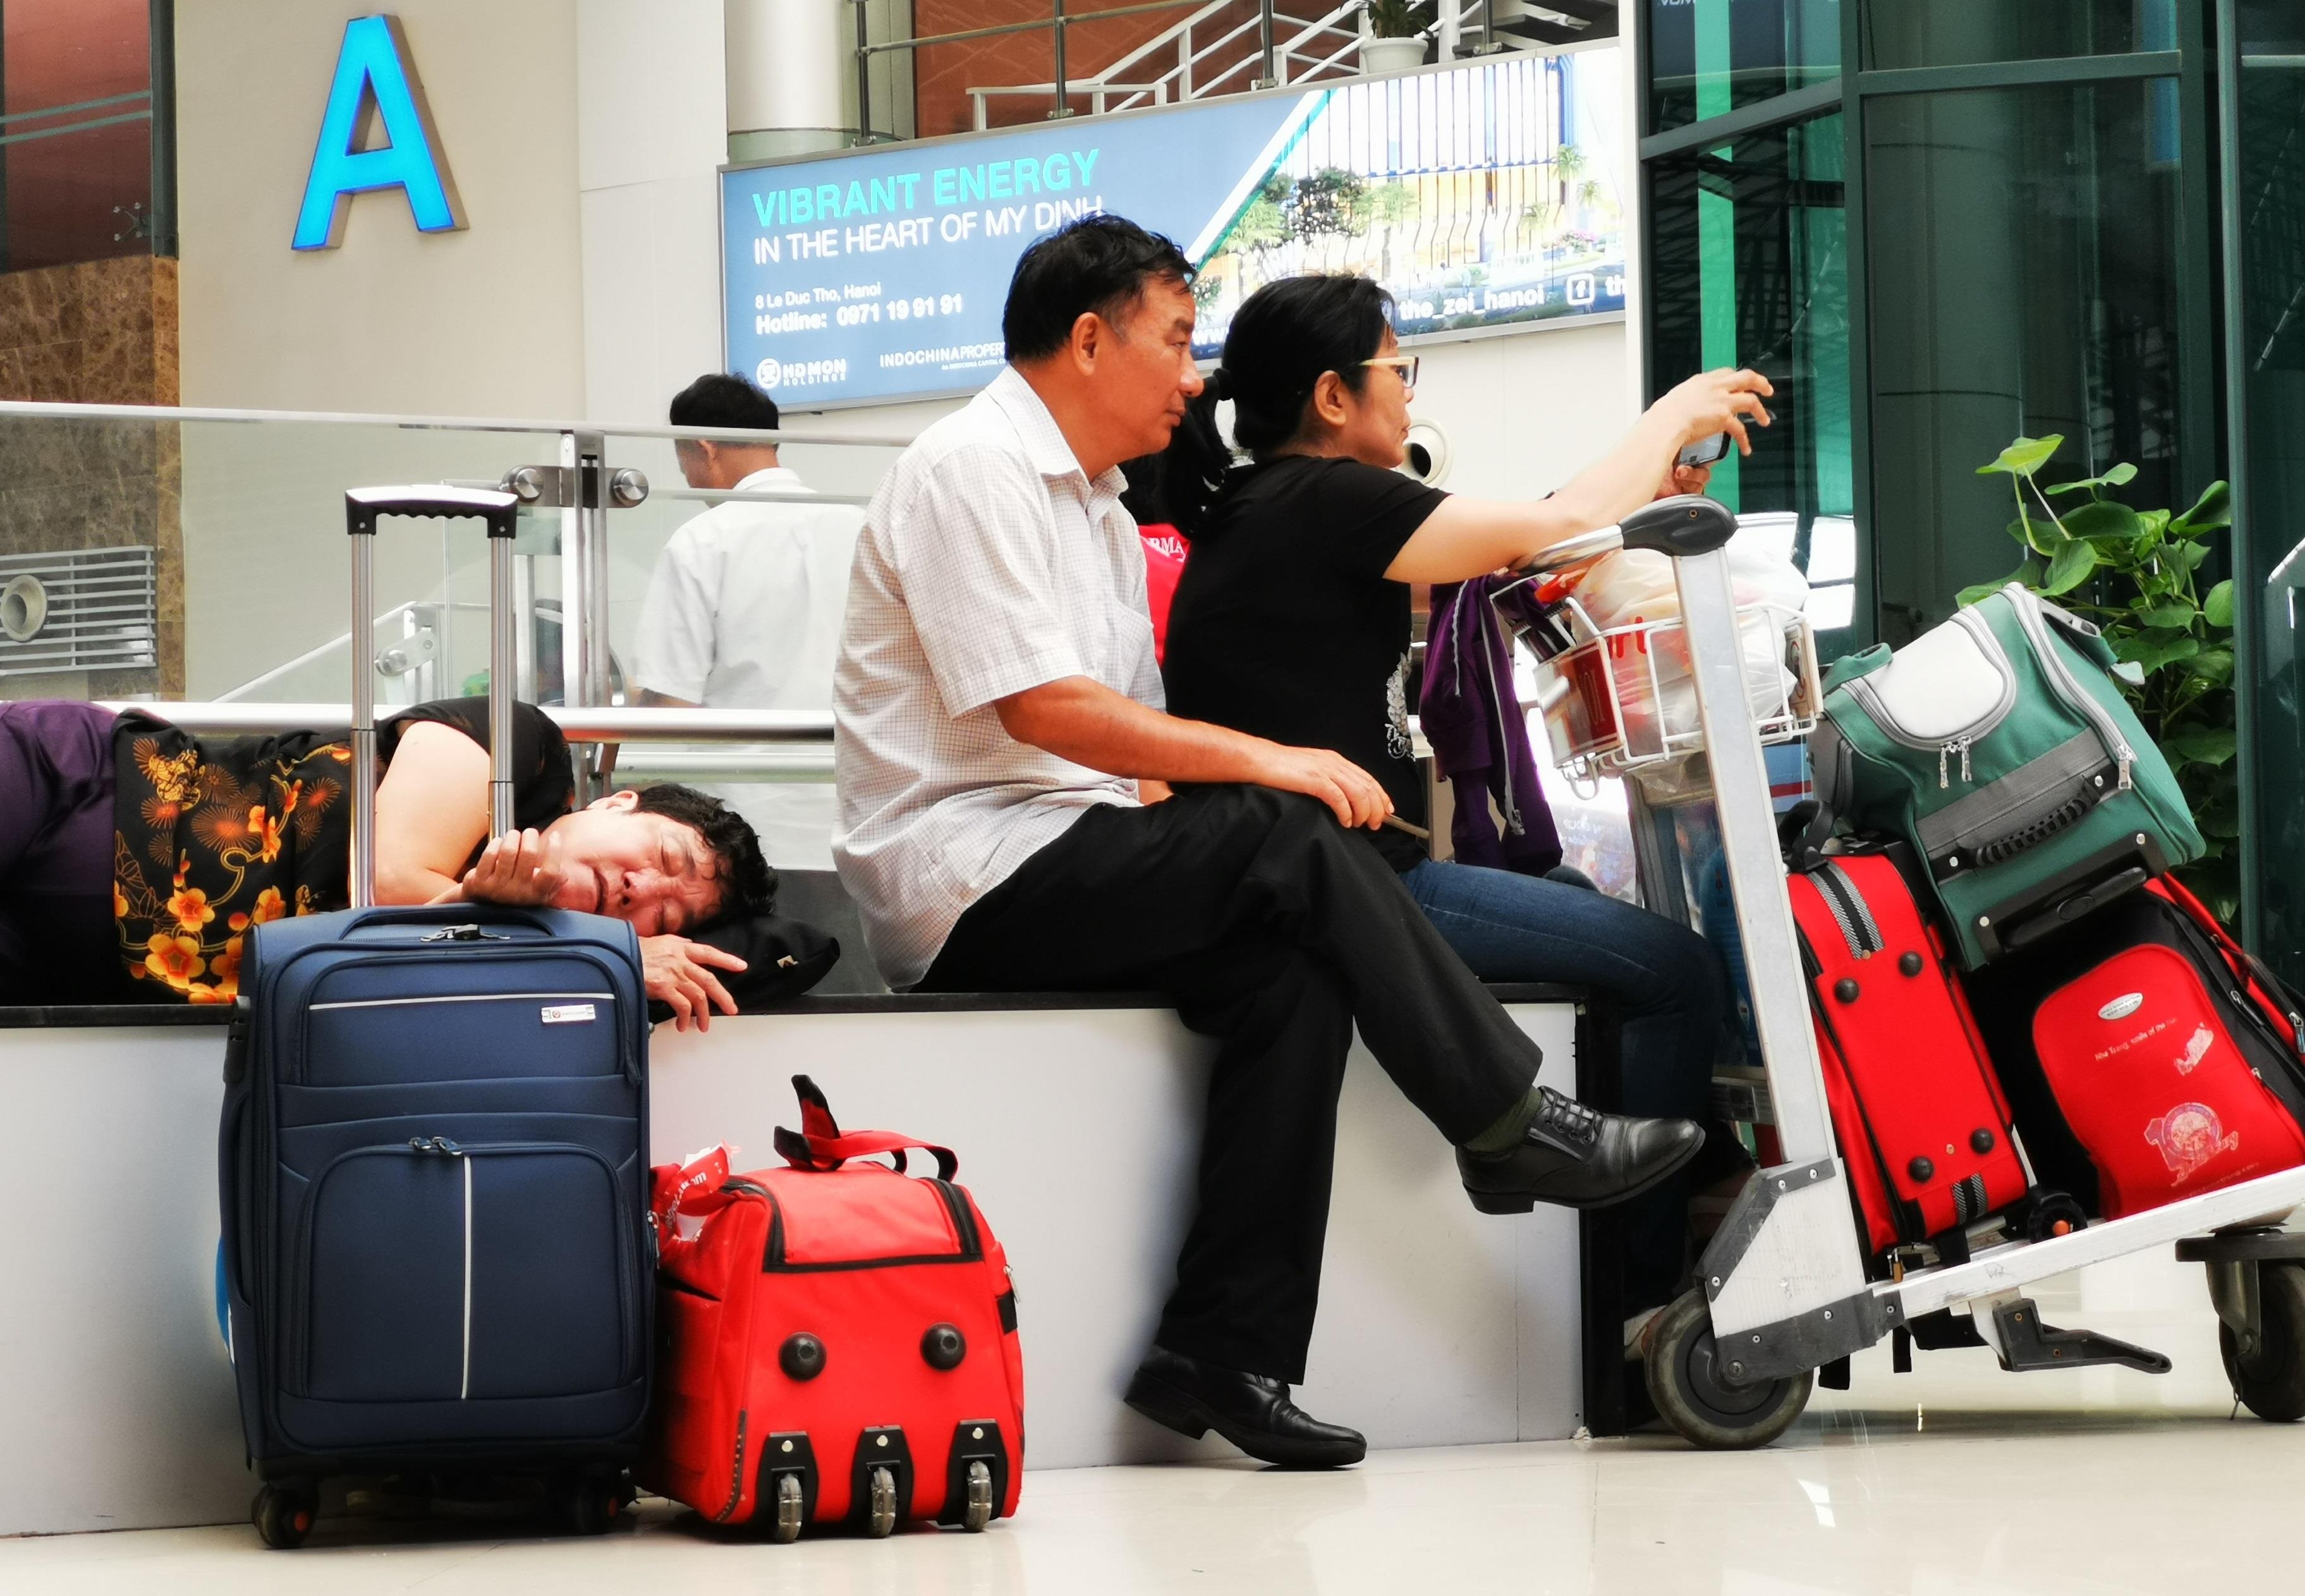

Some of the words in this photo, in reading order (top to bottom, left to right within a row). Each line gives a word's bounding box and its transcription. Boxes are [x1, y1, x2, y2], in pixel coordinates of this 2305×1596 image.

[291, 14, 465, 251] A
[753, 173, 921, 228] VIBRANT
[934, 149, 1099, 206] ENERGY
[754, 236, 781, 265] IN
[786, 228, 839, 260] THE
[845, 216, 934, 254] HEART
[940, 211, 978, 242] OF
[985, 204, 1028, 237] MY
[755, 295, 764, 310] 8
[767, 293, 783, 308] Le
[785, 291, 811, 306] Duc
[813, 287, 841, 302] Tho,
[844, 281, 881, 299] Hanoi
[756, 311, 827, 335] Hotline:
[836, 302, 880, 326] 0971
[886, 299, 909, 320] 19
[913, 296, 934, 318] 91
[940, 293, 962, 315] 91
